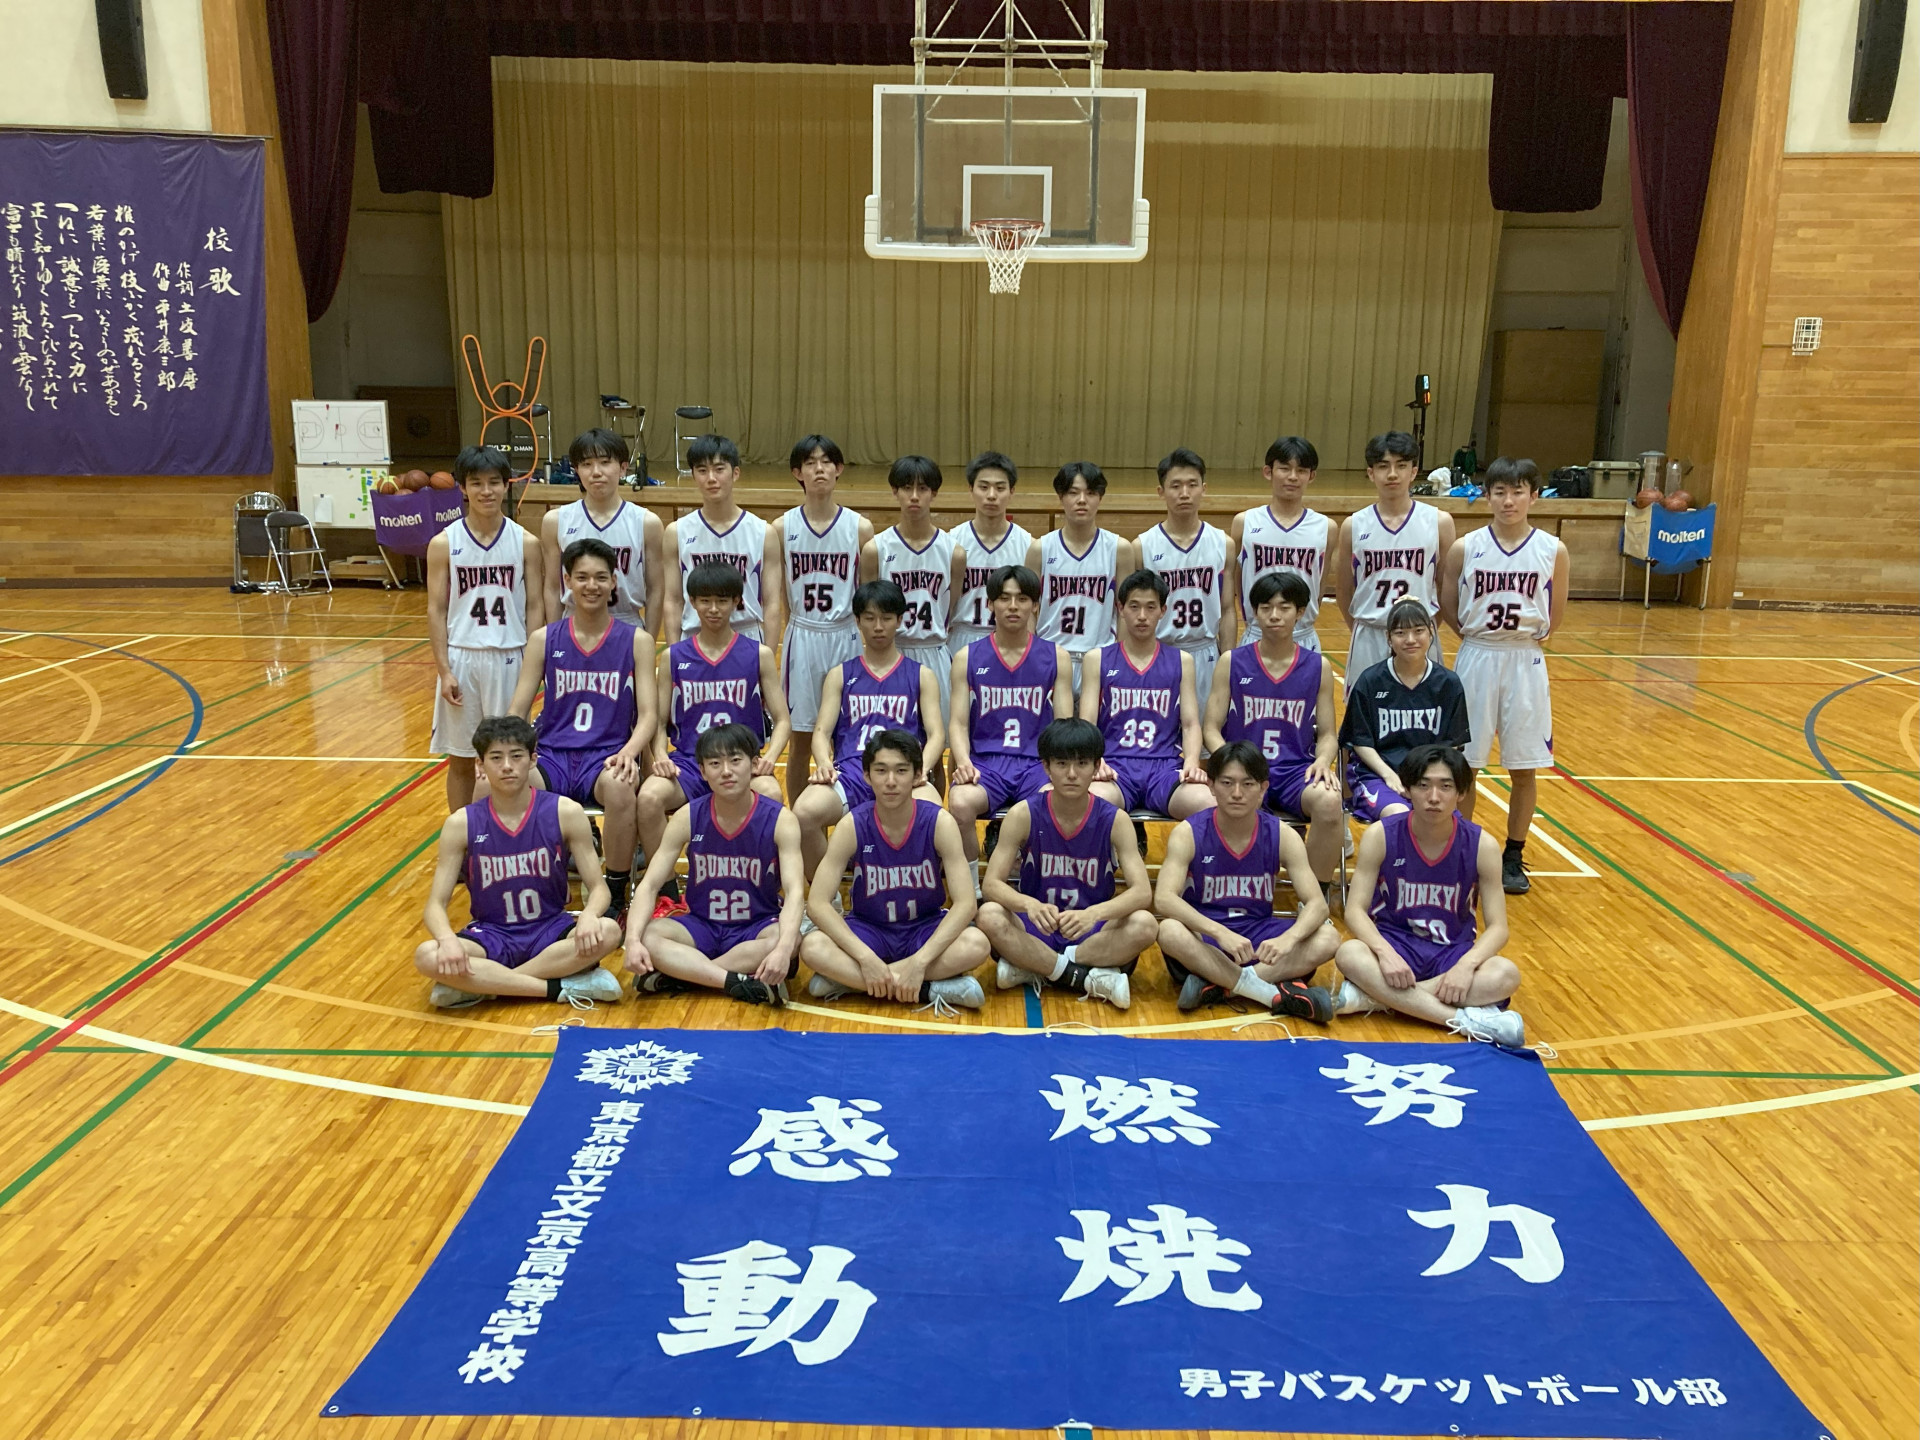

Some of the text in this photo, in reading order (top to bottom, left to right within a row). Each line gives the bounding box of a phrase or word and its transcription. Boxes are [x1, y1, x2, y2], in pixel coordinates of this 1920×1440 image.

[199, 227, 241, 296] 校歌
[380, 514, 423, 528] molten
[435, 506, 462, 522] molten
[1658, 529, 1706, 544] molten
[790, 552, 850, 584] BUNKYO
[1252, 543, 1316, 576] BUNKYO
[1364, 548, 1425, 580] BUNKYO
[455, 564, 515, 598] BUNKYO
[804, 583, 834, 612] 55
[1050, 574, 1107, 606] BUNKYO
[1474, 568, 1539, 601] BUNKYO
[470, 597, 507, 626] 44
[904, 601, 932, 631] 34
[1061, 606, 1086, 635] 21
[1173, 599, 1203, 629] 38
[1486, 603, 1521, 631] 35
[555, 668, 620, 701] BUNKYO
[681, 679, 747, 713] BUNKYO
[573, 702, 593, 732] 0
[849, 695, 908, 726] BUNKYO
[980, 685, 1043, 718] BUNKYO
[1110, 687, 1172, 719] BUNKYO
[1243, 696, 1305, 729] BUNKYO
[1003, 718, 1021, 748] 2
[1119, 718, 1157, 748] 33
[1263, 730, 1281, 760] 5
[480, 847, 550, 890] BUNKYO
[694, 852, 761, 888] BUNKYO
[866, 858, 937, 898] BUNKYO
[1041, 853, 1099, 888] UNKYO
[503, 888, 542, 924] 10
[708, 888, 751, 922] 22
[886, 898, 919, 924] 11
[1396, 877, 1461, 915] BUNKY
[1319, 1053, 1564, 1284] 努力
[1039, 1074, 1263, 1311] 燃焼
[458, 1099, 645, 1384] 東京都立文京高等学校
[657, 1096, 898, 1366] 感動
[1179, 1367, 1728, 1408] 男子バスケットボール部
